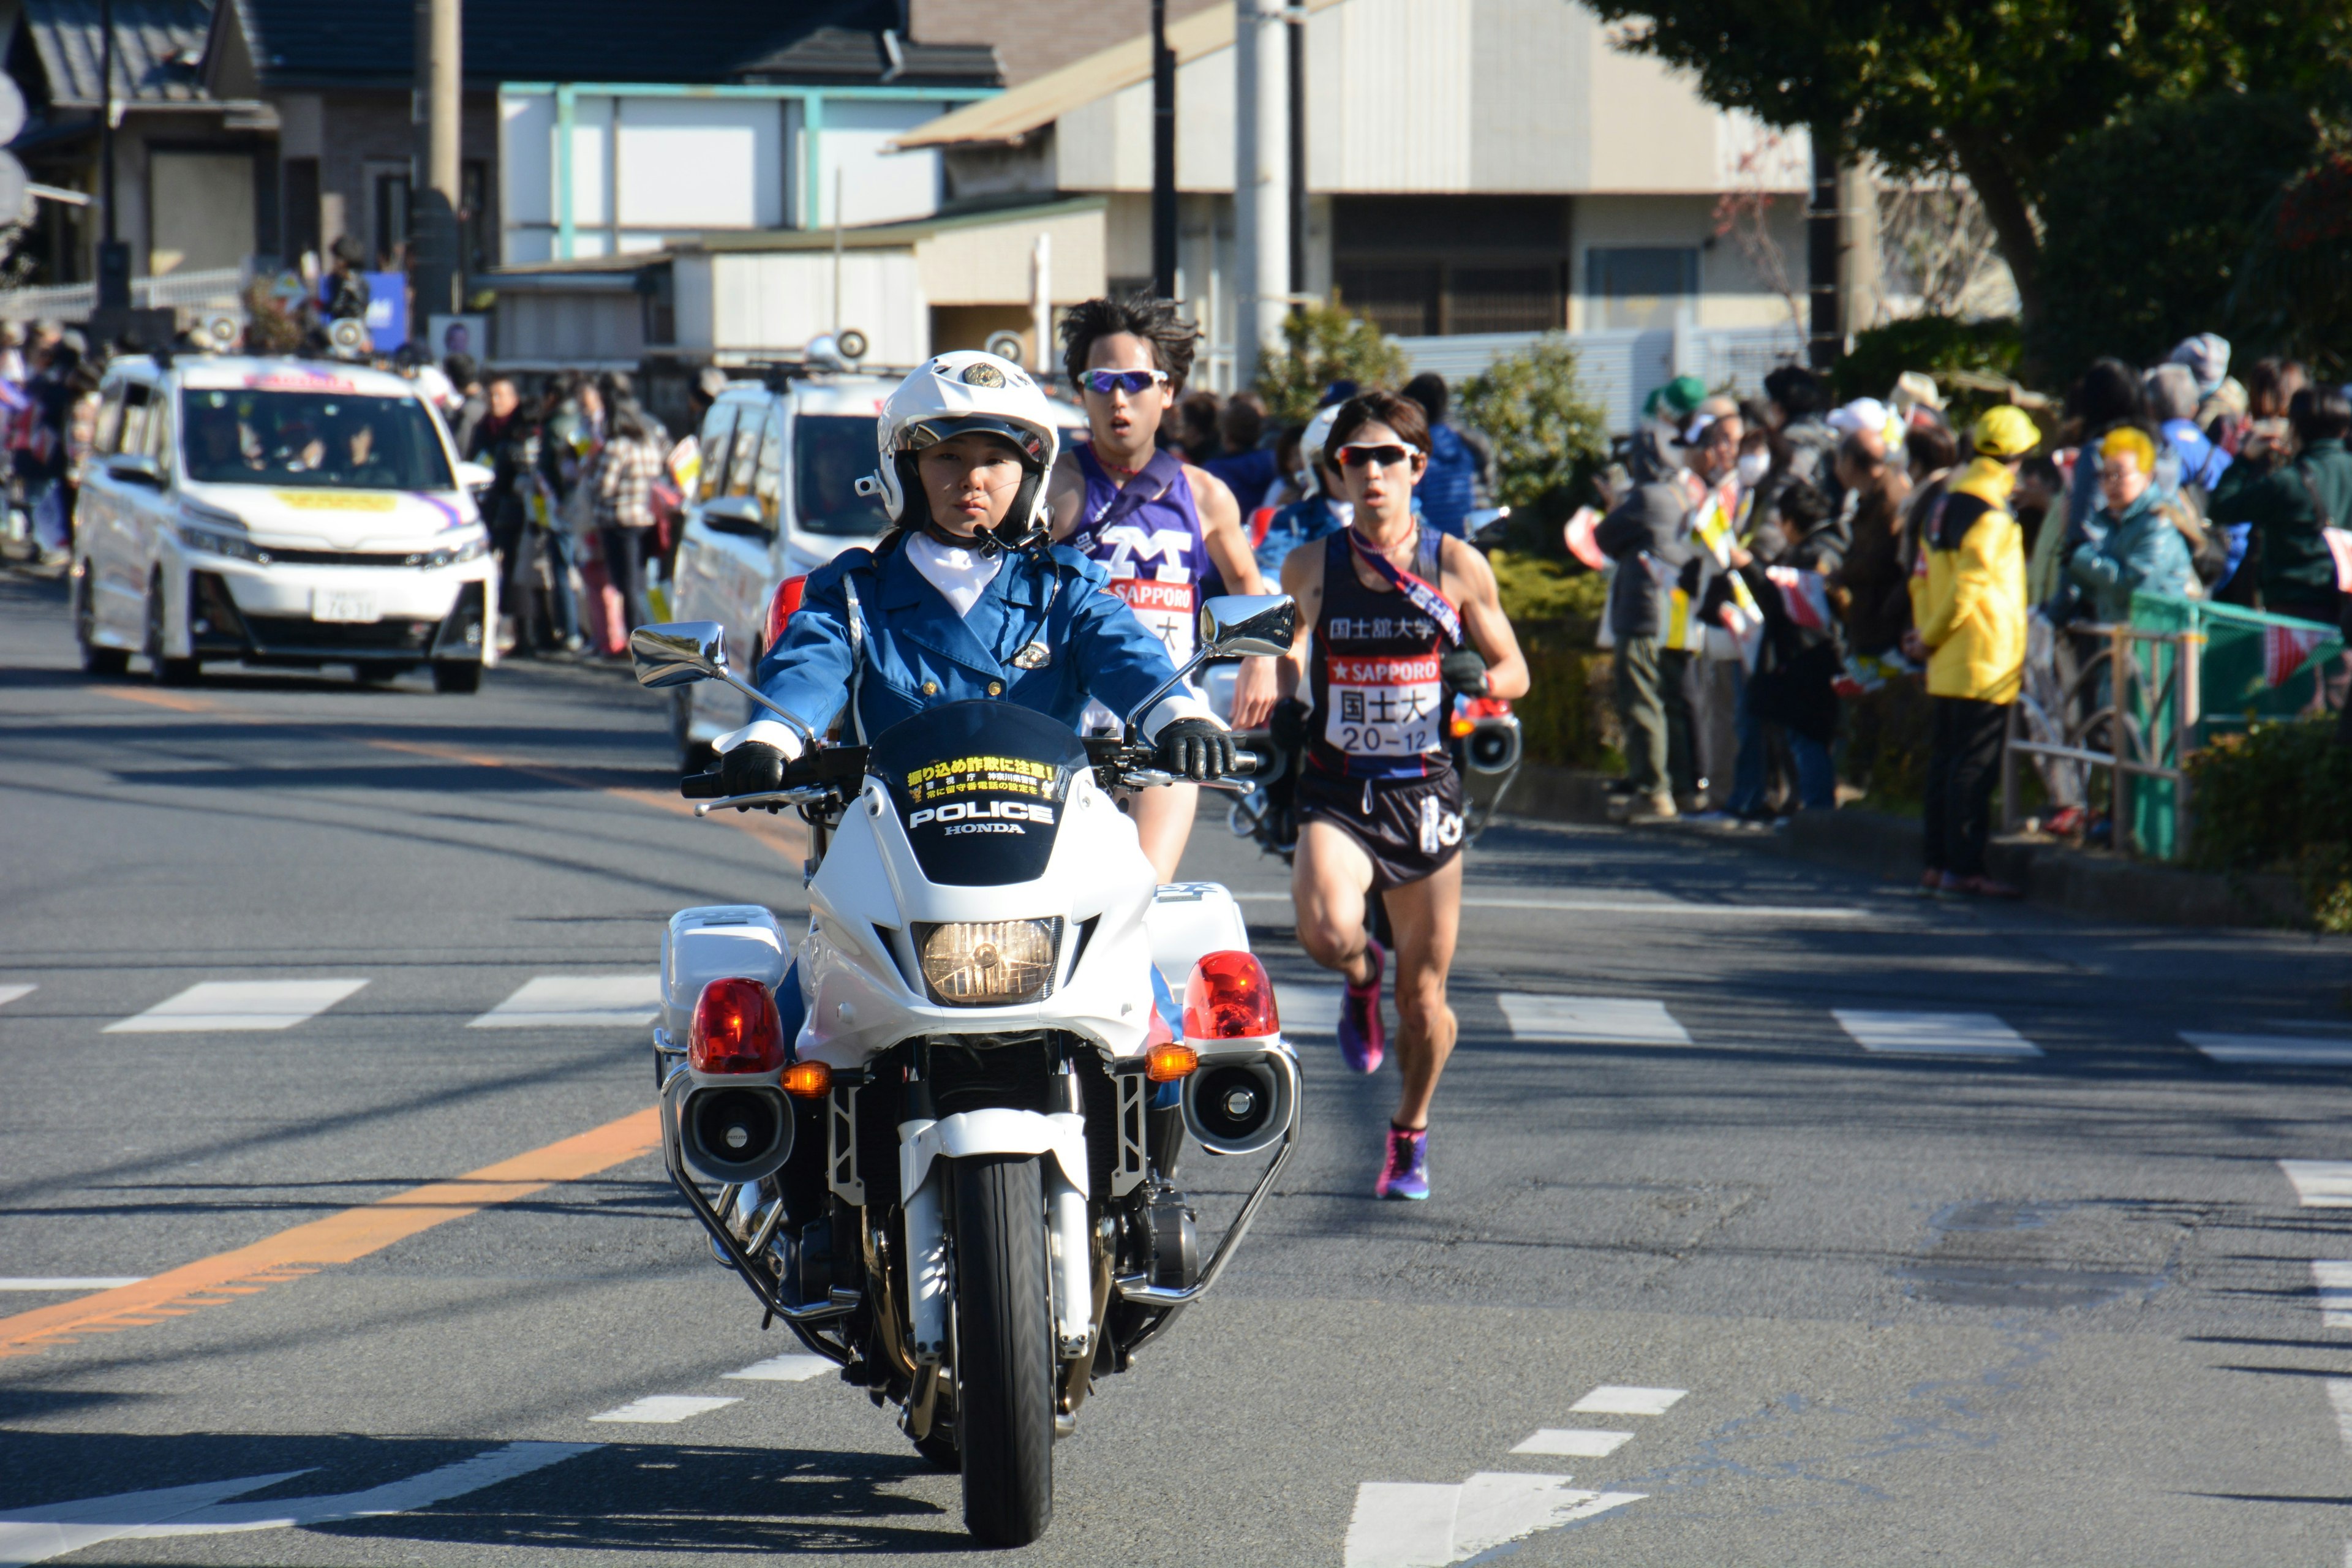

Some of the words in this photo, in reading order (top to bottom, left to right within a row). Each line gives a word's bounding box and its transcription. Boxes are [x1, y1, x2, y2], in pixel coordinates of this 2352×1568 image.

[1094, 526, 1192, 584] M
[1115, 584, 1190, 608] SAPPORO
[1352, 661, 1437, 681] SAPPORO
[1341, 690, 1427, 724] 国士大
[1343, 727, 1426, 751] 20-12
[926, 781, 1038, 799] 常に留守番電話の設定を
[910, 801, 1054, 829] POLICE
[944, 823, 1026, 836] HONDA
